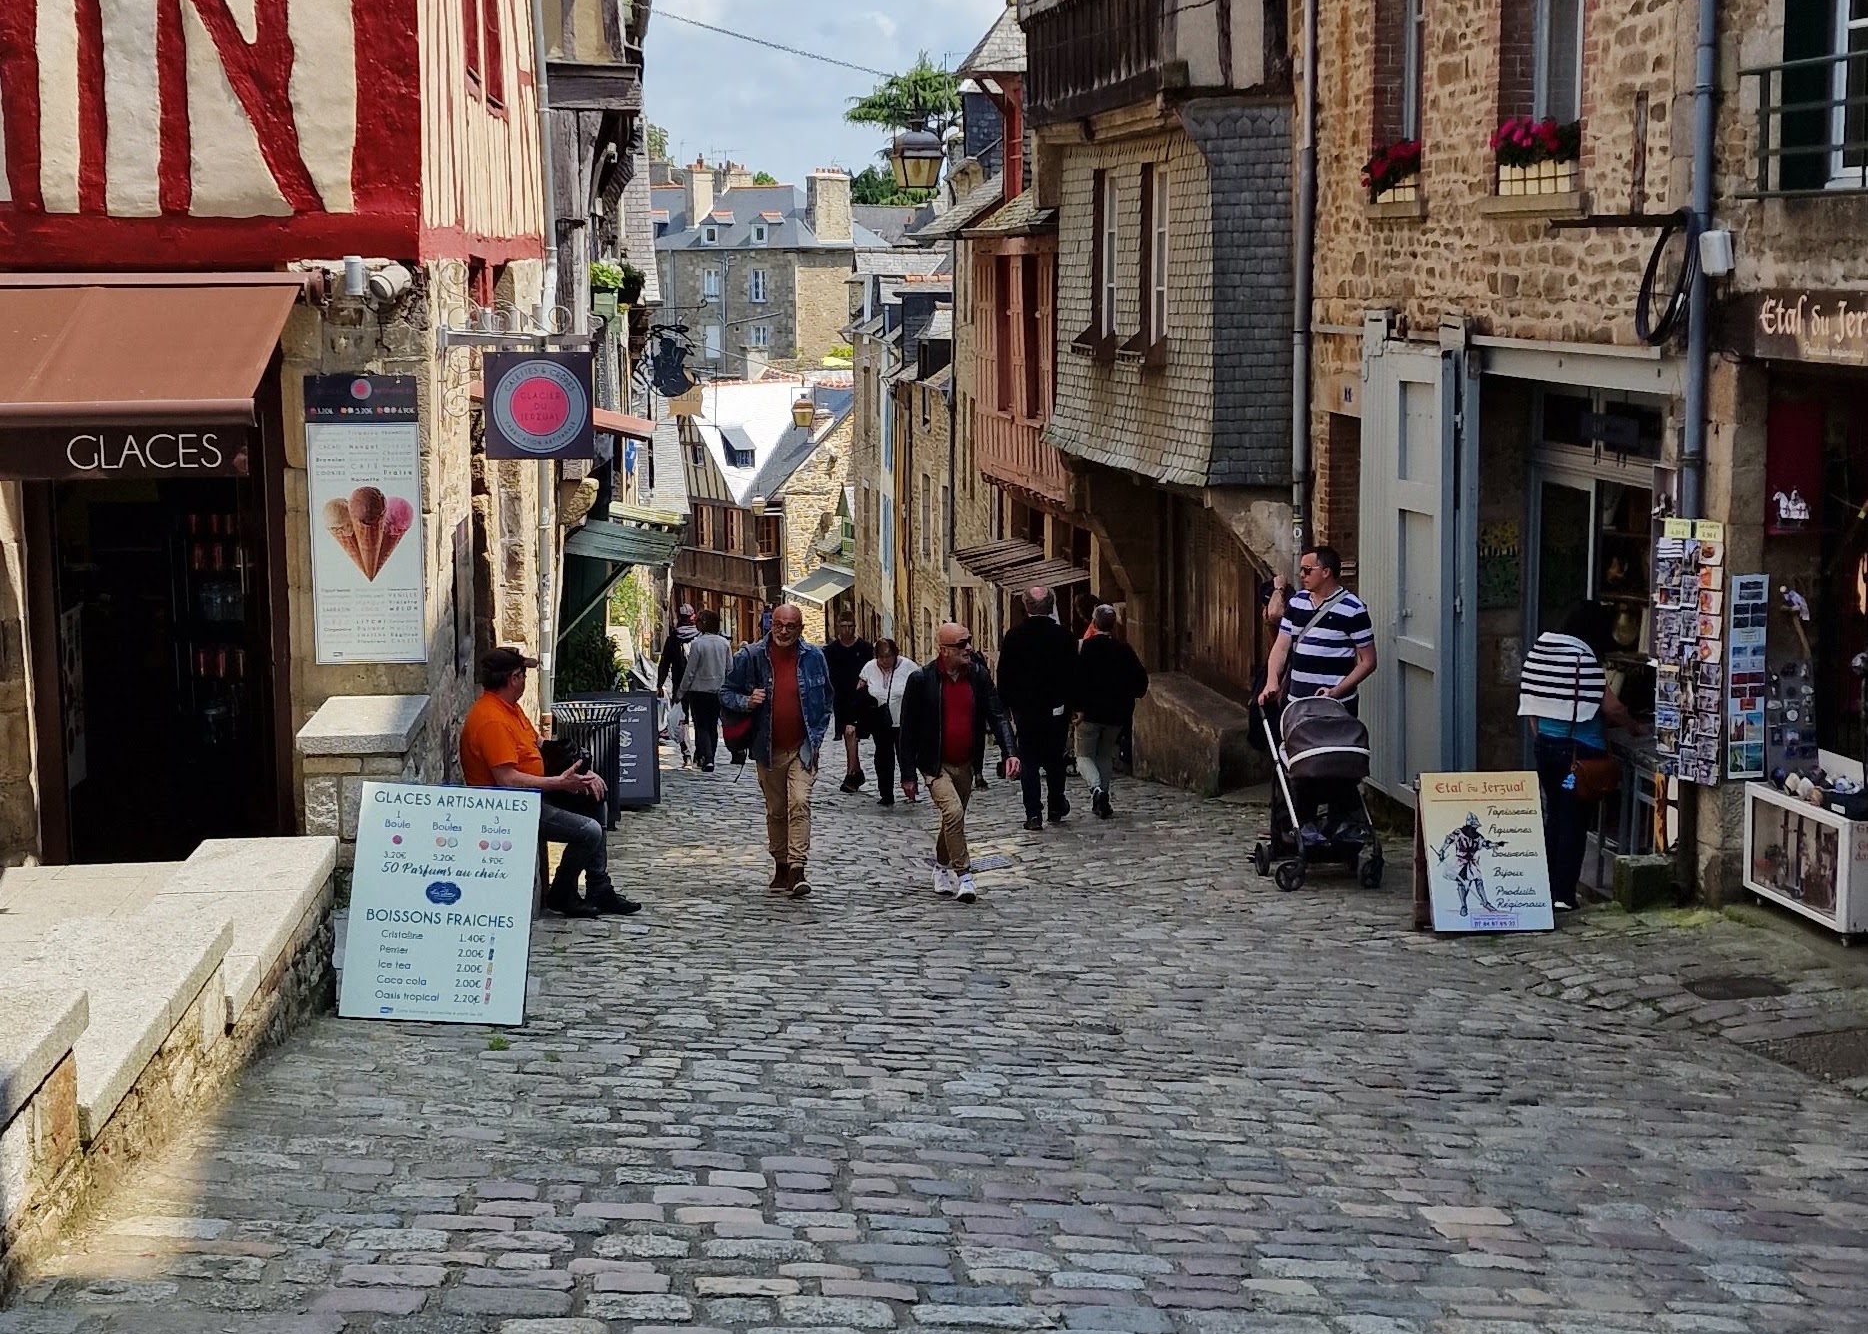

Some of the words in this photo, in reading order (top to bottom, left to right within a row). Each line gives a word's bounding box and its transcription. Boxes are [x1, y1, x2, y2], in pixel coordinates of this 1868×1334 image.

[1759, 295, 1807, 335] Etal
[1811, 305, 1829, 336] du
[1833, 301, 1868, 343] Jer
[520, 392, 560, 400] GLACIER
[521, 413, 560, 421] JERZUAL
[67, 433, 222, 470] GLACES
[1434, 781, 1463, 793] Etal
[1481, 780, 1526, 795] Jerzual
[374, 790, 432, 805] GLACES
[436, 795, 528, 812] ARTISANALES
[396, 810, 401, 818] 1
[1486, 805, 1538, 816] Tapisseries
[384, 818, 411, 829] Boule
[445, 813, 452, 822] 2
[494, 816, 500, 825] 3
[432, 822, 463, 832] Boules
[481, 825, 511, 835] Boules
[1488, 823, 1532, 835] Figurines
[1491, 846, 1539, 858] Souvenirs
[381, 861, 399, 873] 50
[401, 862, 451, 877] Parfums
[455, 869, 472, 878] au
[474, 867, 509, 880] choix
[1493, 867, 1524, 878] Bijoux
[1495, 885, 1537, 896] Produits
[1496, 898, 1547, 911] Régionaux
[366, 908, 442, 925] BOISSONS
[446, 913, 514, 929] FRAICHES
[381, 929, 424, 940] Cristaline
[459, 933, 486, 943] 1.40€
[379, 945, 409, 955] Perrier
[457, 948, 484, 958] 2.00€
[378, 960, 393, 969] Ice
[395, 960, 411, 970] tea
[456, 964, 483, 974] 2.00€
[376, 974, 403, 985] Coca
[405, 976, 427, 986] cola
[455, 979, 482, 989] 2.00€
[375, 990, 401, 1000] Oasis
[403, 992, 440, 1003] tropical
[453, 994, 480, 1004] 2.20€
